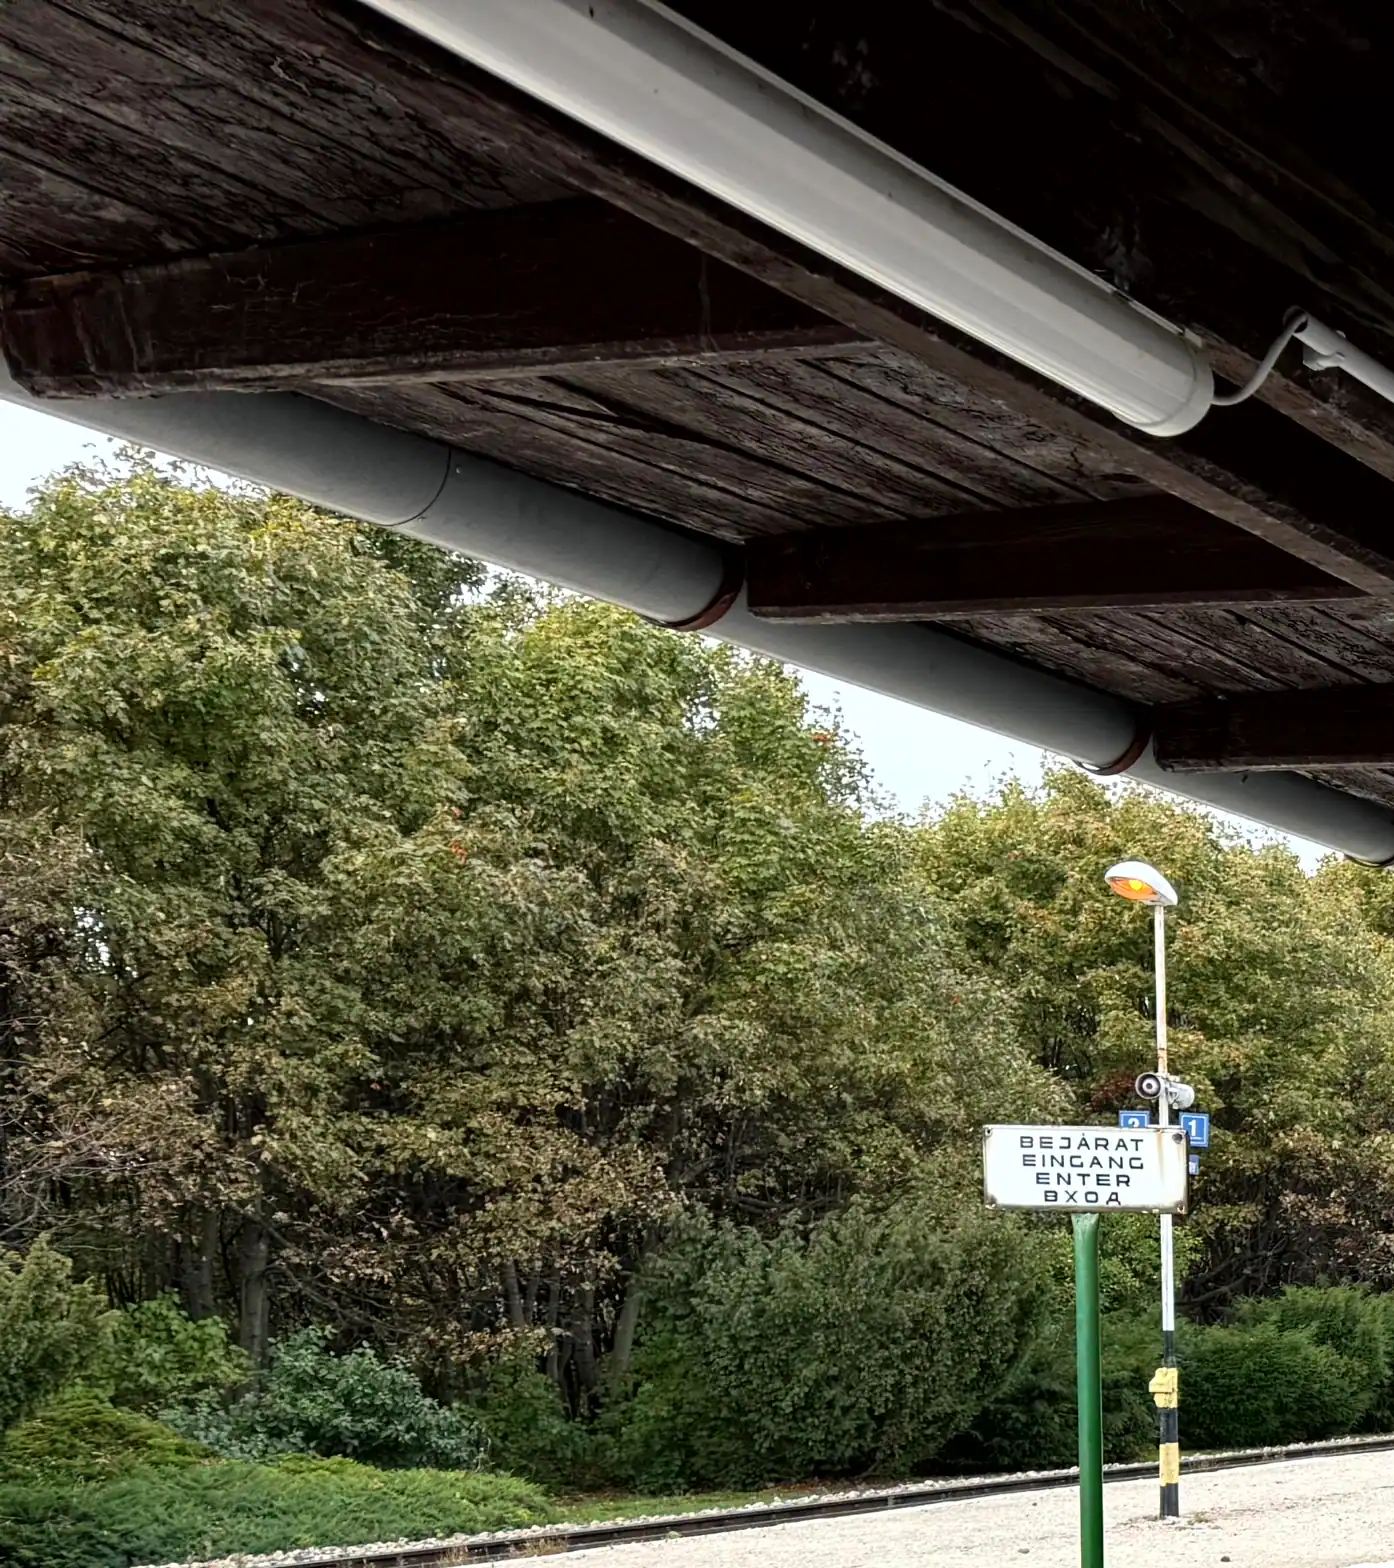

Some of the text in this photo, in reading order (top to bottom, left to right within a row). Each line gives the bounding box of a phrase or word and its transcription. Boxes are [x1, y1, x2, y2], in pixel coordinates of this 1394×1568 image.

[1188, 1119, 1197, 1137] 1
[1020, 1133, 1144, 1151] BEJÁRAT
[1022, 1154, 1144, 1170] EINGANG
[1036, 1172, 1131, 1187] ENTER
